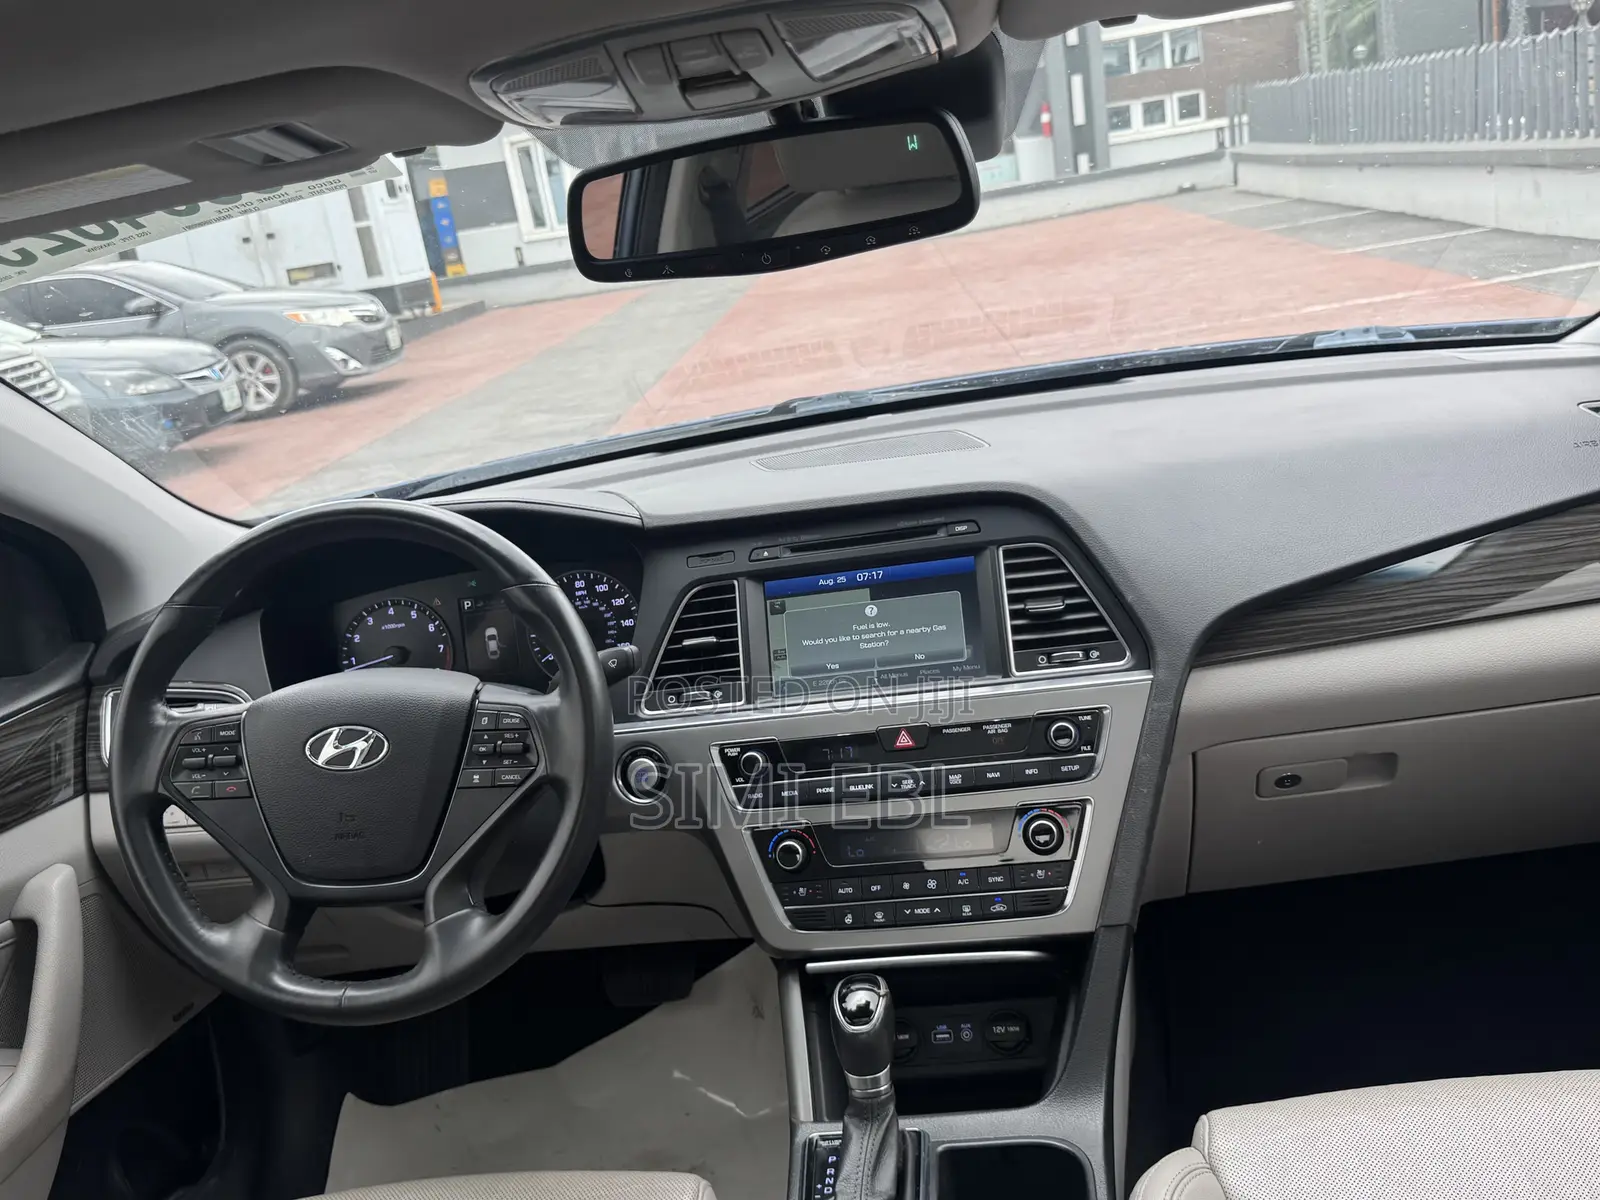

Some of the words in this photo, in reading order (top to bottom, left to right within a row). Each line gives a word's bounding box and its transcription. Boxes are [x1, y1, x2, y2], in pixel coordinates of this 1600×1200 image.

[906, 134, 918, 151] W
[819, 578, 835, 586] Aug.
[856, 570, 883, 582] 07:17
[574, 580, 585, 589] 80
[594, 583, 609, 593] 100
[464, 601, 472, 610] P
[611, 597, 625, 607] 120
[387, 607, 395, 616] 4
[410, 610, 418, 619] 5
[366, 616, 374, 626] 3
[620, 618, 634, 628] 140
[428, 623, 435, 632] 6
[852, 623, 868, 631] Fuel
[353, 634, 361, 643] 2
[802, 637, 824, 646] Would
[824, 637, 838, 645] you
[861, 631, 886, 640] search
[906, 625, 932, 635] nearby
[932, 624, 947, 632] Gas
[437, 644, 445, 653] 7
[860, 640, 890, 650] Station?
[350, 657, 356, 665] 1
[826, 662, 840, 670] Yes
[942, 726, 972, 734] PASSENGER
[982, 722, 1012, 730] PASSENGER
[1060, 764, 1080, 772] SETUP
[816, 786, 836, 794] PHONE
[849, 784, 874, 792] BLUELINK
[957, 878, 970, 886] A/C
[838, 886, 853, 894] AUTO
[870, 884, 882, 892] OFF
[992, 1026, 1006, 1034] 12V
[828, 1155, 837, 1164] P
[826, 1168, 835, 1176] R
[825, 1177, 834, 1185] N
[824, 1186, 833, 1194] D
